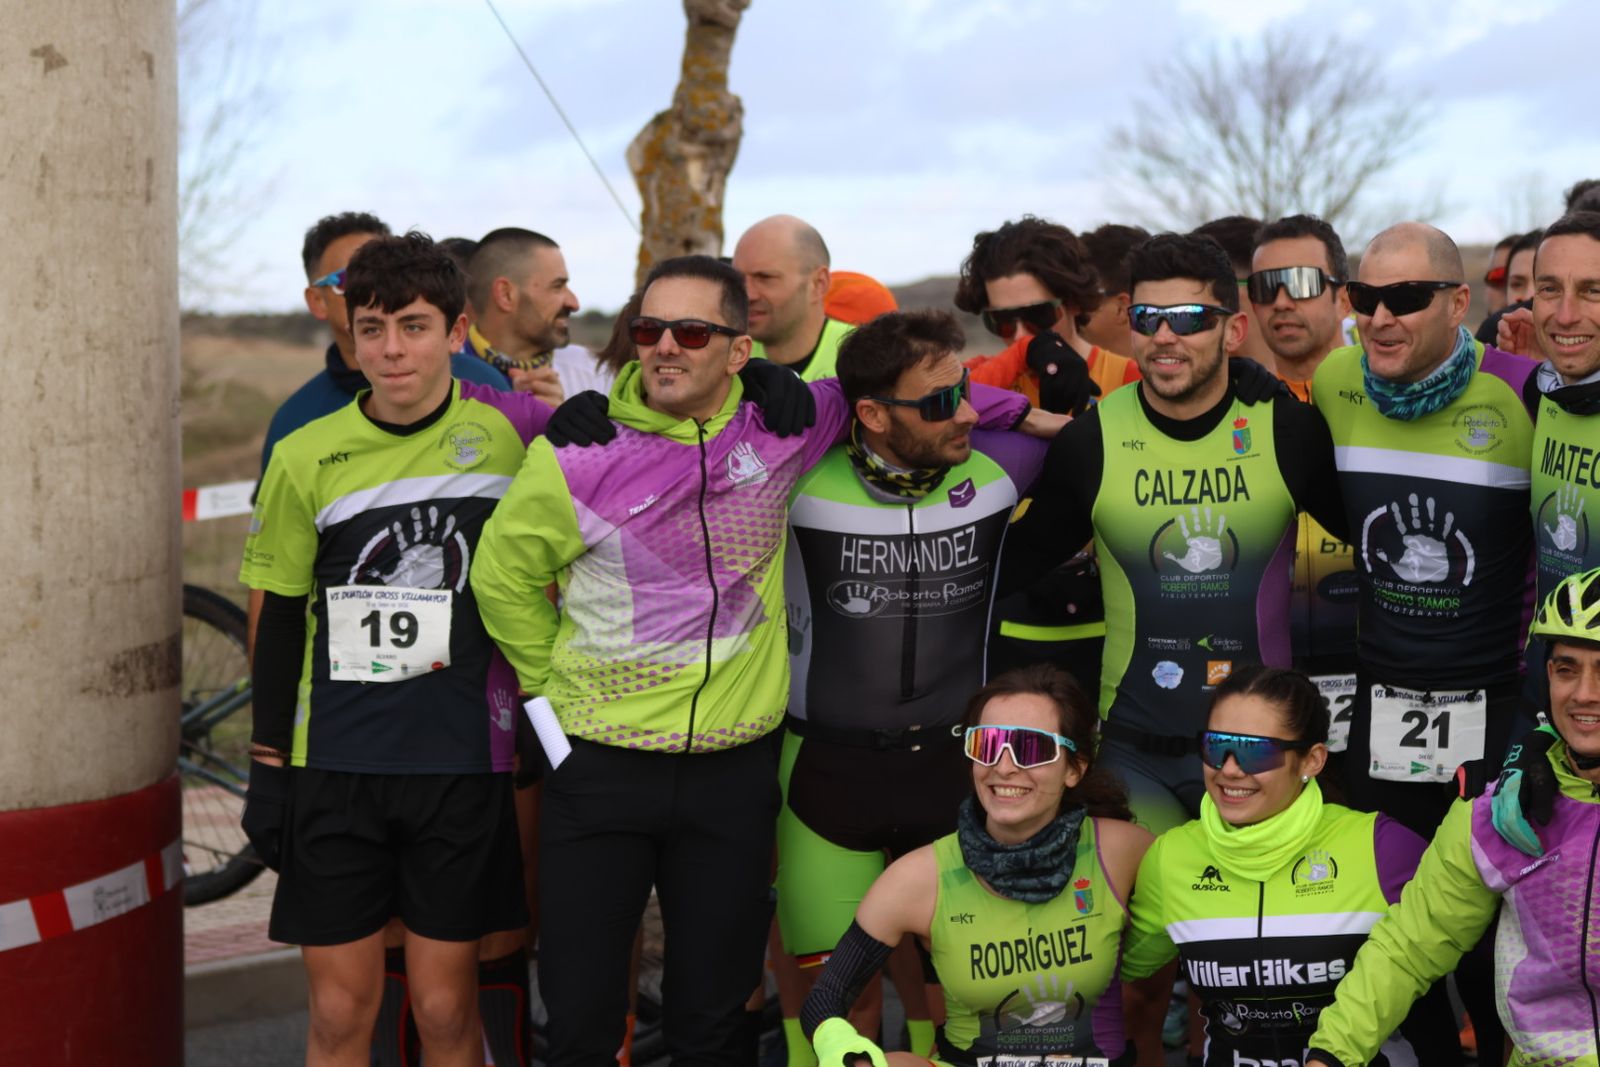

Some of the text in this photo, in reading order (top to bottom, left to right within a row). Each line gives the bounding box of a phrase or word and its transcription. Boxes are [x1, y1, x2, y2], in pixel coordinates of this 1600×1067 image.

[1135, 465, 1251, 507] CALZADA
[1183, 573, 1230, 582] DEPORTIVO
[869, 586, 941, 603] Roberto
[943, 579, 984, 602] Ramos
[1160, 581, 1230, 592] ROBERTO RAMOS
[330, 591, 340, 601] VI
[375, 590, 400, 600] CROSS
[401, 592, 448, 604] VILLAMAYOR
[1417, 596, 1461, 609] RAMOS
[360, 609, 419, 649] 19
[1321, 679, 1343, 688] CROSS
[1374, 689, 1384, 698] VI
[1399, 709, 1451, 749] 21
[970, 924, 1093, 980] RODRÍGUEZ
[1024, 1025, 1074, 1035] DEPORTIVO
[997, 1033, 1075, 1044] ROBERTO RAMOS
